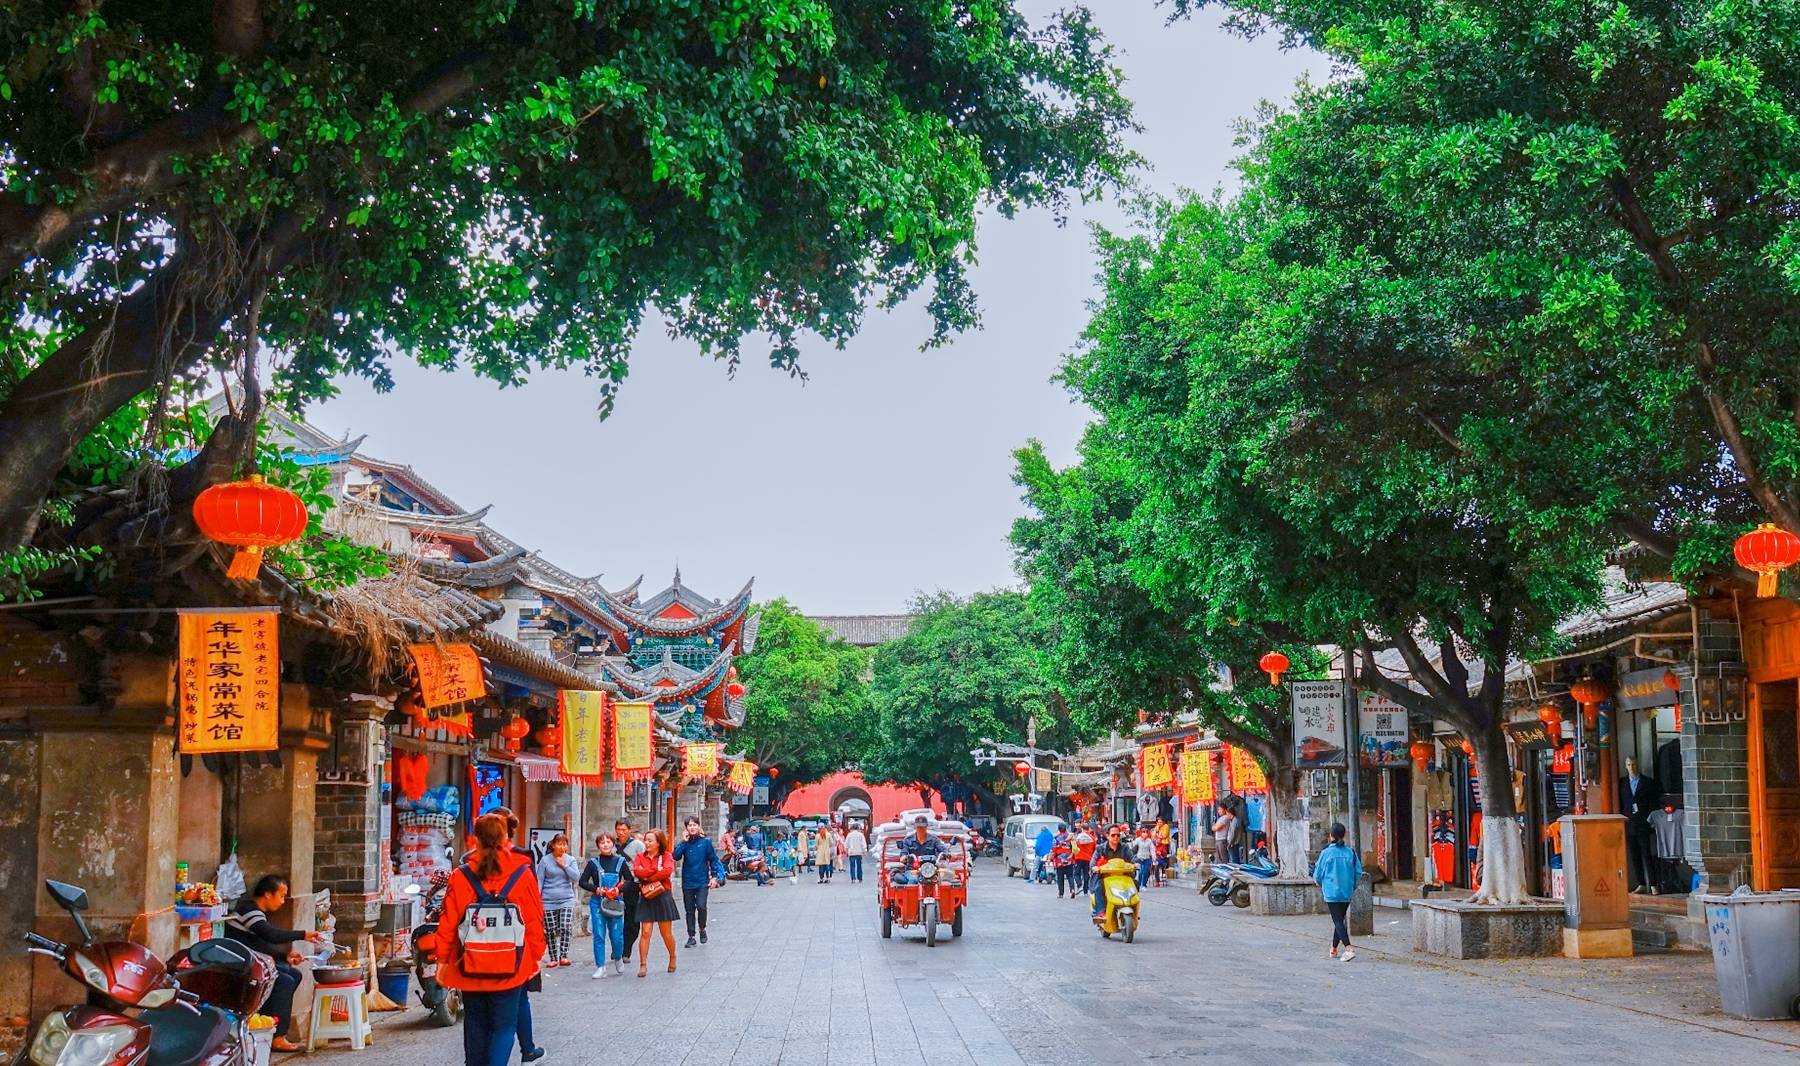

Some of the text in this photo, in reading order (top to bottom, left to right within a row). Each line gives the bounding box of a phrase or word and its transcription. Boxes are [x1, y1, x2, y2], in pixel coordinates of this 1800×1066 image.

[207, 620, 245, 740] 年华家常菜馆
[575, 690, 591, 765] 百年老店
[1146, 755, 1167, 775] 39
